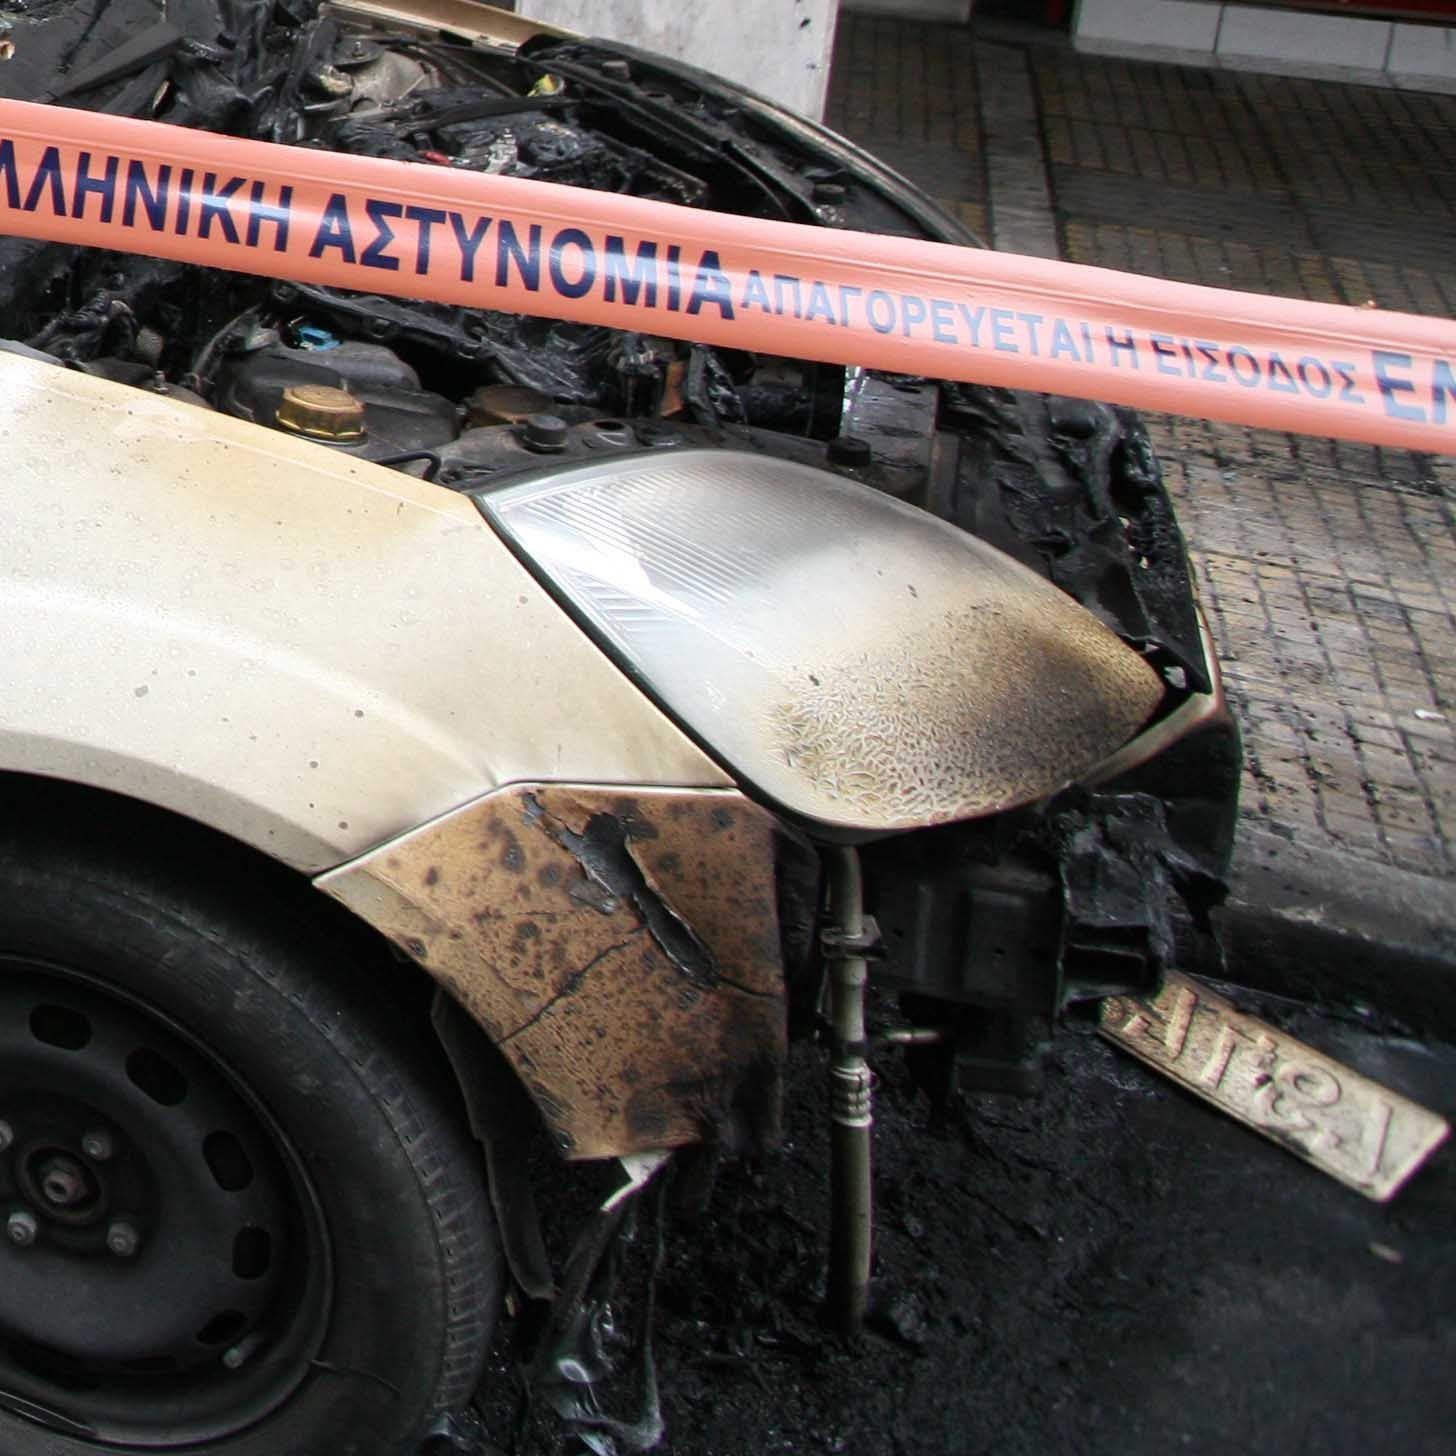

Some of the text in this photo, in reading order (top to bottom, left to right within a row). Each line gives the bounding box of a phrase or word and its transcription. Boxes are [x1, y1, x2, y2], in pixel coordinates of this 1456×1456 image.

[309, 193, 736, 320] ΑΣΤΥΝΟΜΙΑ
[740, 269, 1094, 363] ΑΠΑΓΟΡΕΥΕΤΑΙ
[1106, 326, 1139, 370] Η
[1151, 334, 1366, 404] ΕΙΣΟΔΟΣ
